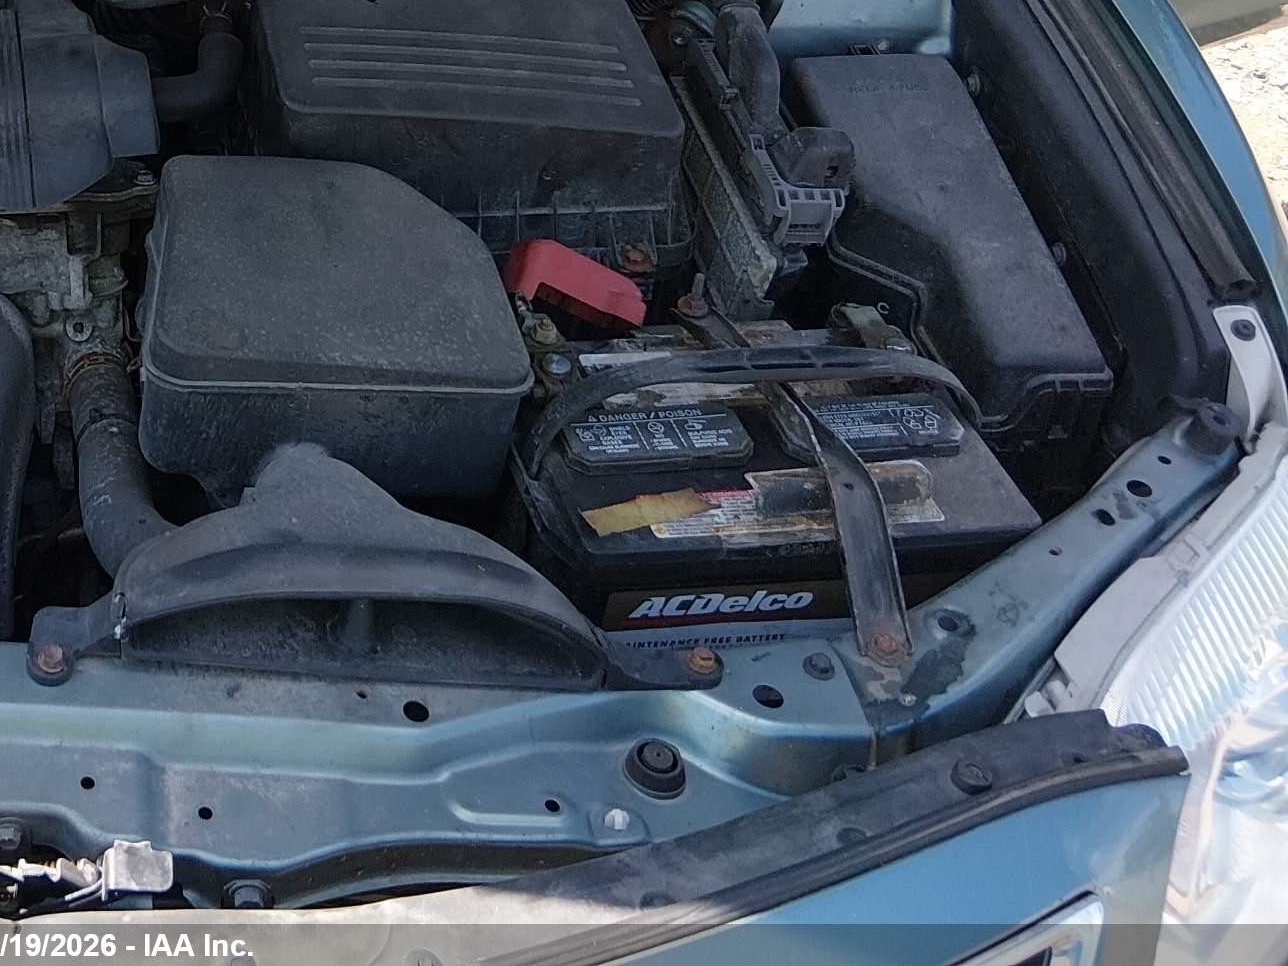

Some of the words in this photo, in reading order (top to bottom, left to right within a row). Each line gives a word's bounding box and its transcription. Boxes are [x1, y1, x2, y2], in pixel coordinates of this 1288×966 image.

[598, 412, 648, 422] DANGER
[649, 411, 656, 419] /
[658, 408, 703, 418] POISON
[627, 590, 815, 619] ACDelco
[625, 636, 700, 650] INTENANCE
[703, 635, 732, 646] FREE
[735, 633, 787, 644] BATTERY
